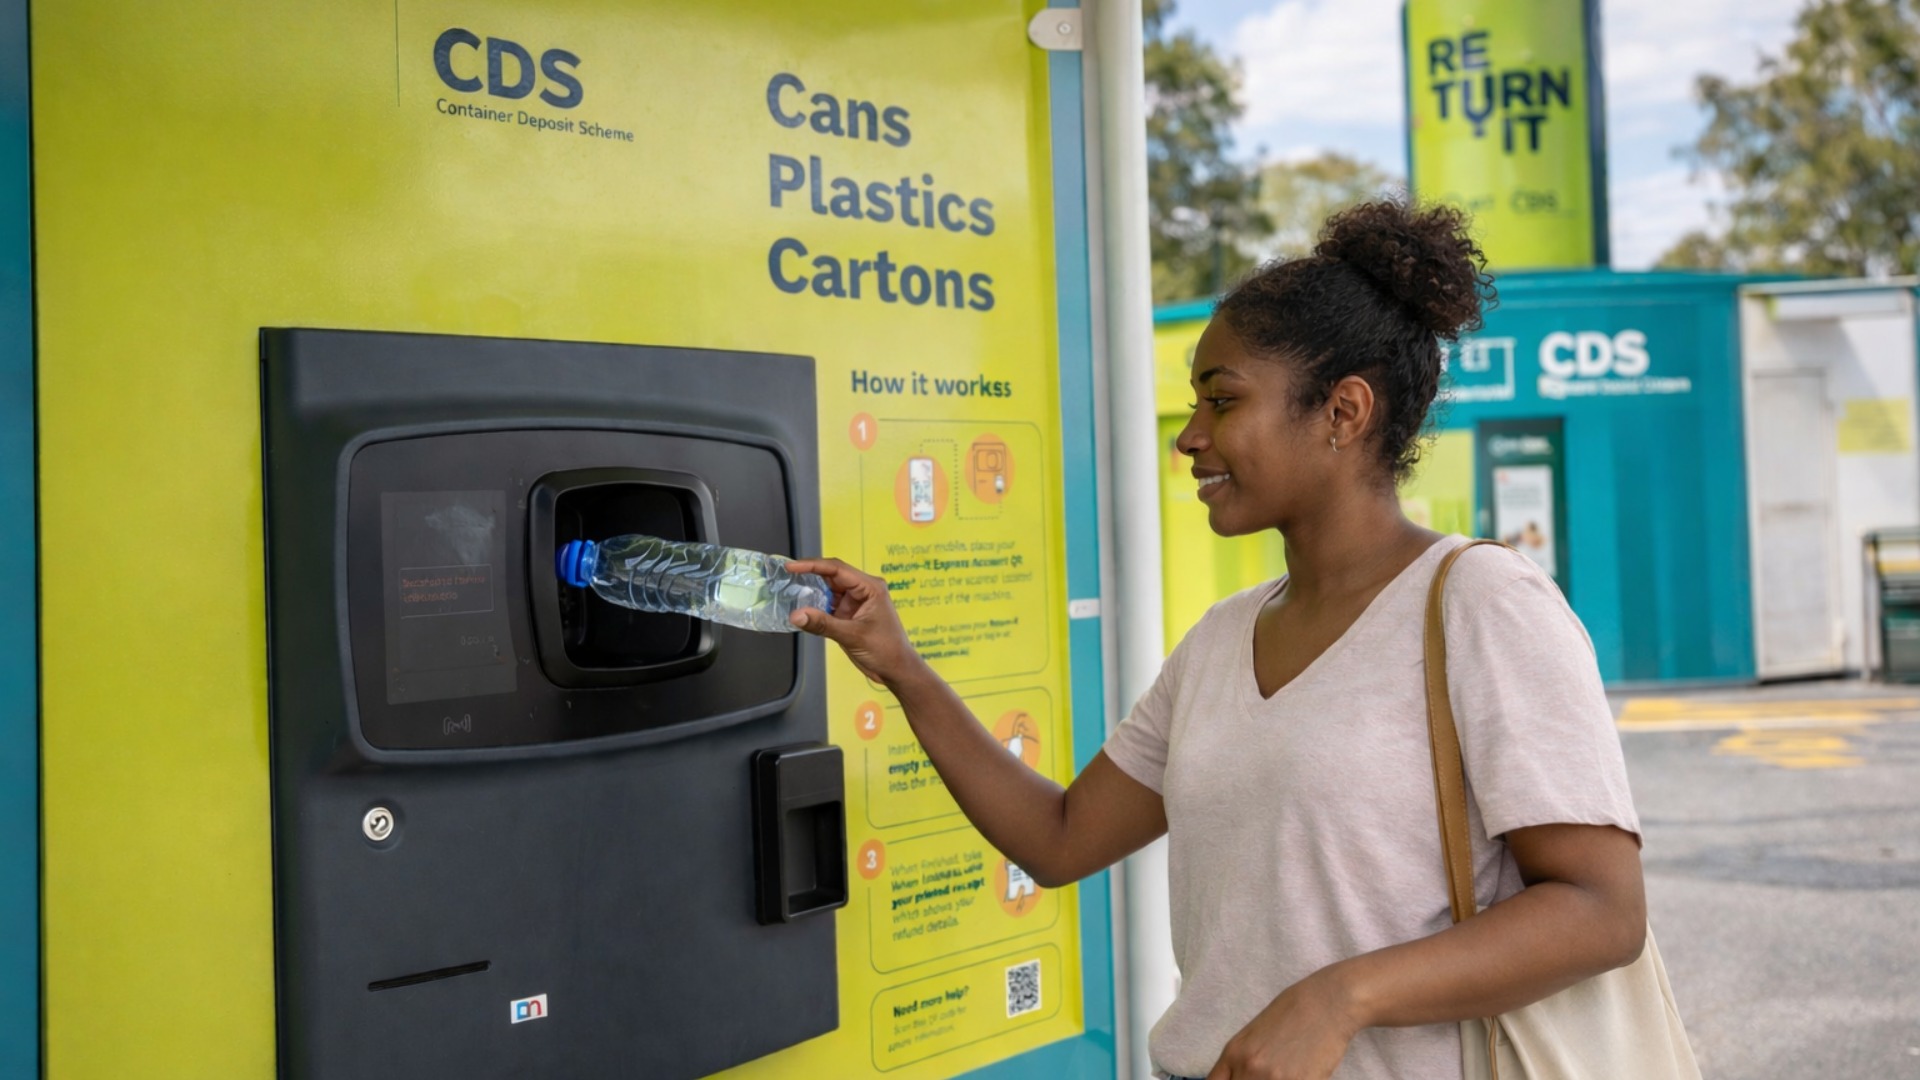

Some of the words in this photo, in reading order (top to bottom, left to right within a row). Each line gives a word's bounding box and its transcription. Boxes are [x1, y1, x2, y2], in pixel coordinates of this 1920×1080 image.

[433, 27, 584, 109] CDS
[1428, 30, 1490, 76] RE
[436, 98, 514, 124] Container
[517, 110, 574, 135] Deposit
[579, 119, 634, 142] Scheme
[766, 72, 912, 148] Cans
[1431, 69, 1571, 138] TURN
[1503, 114, 1548, 153] IT
[768, 153, 996, 237] Plastics
[767, 237, 996, 312] Cartons
[1538, 329, 1650, 377] CDS
[851, 369, 905, 394] How
[911, 371, 929, 395] it
[857, 420, 867, 441] 1
[864, 711, 876, 730] 2
[866, 850, 877, 870] 3
[893, 1000, 918, 1018] Need
[920, 994, 942, 1009] more
